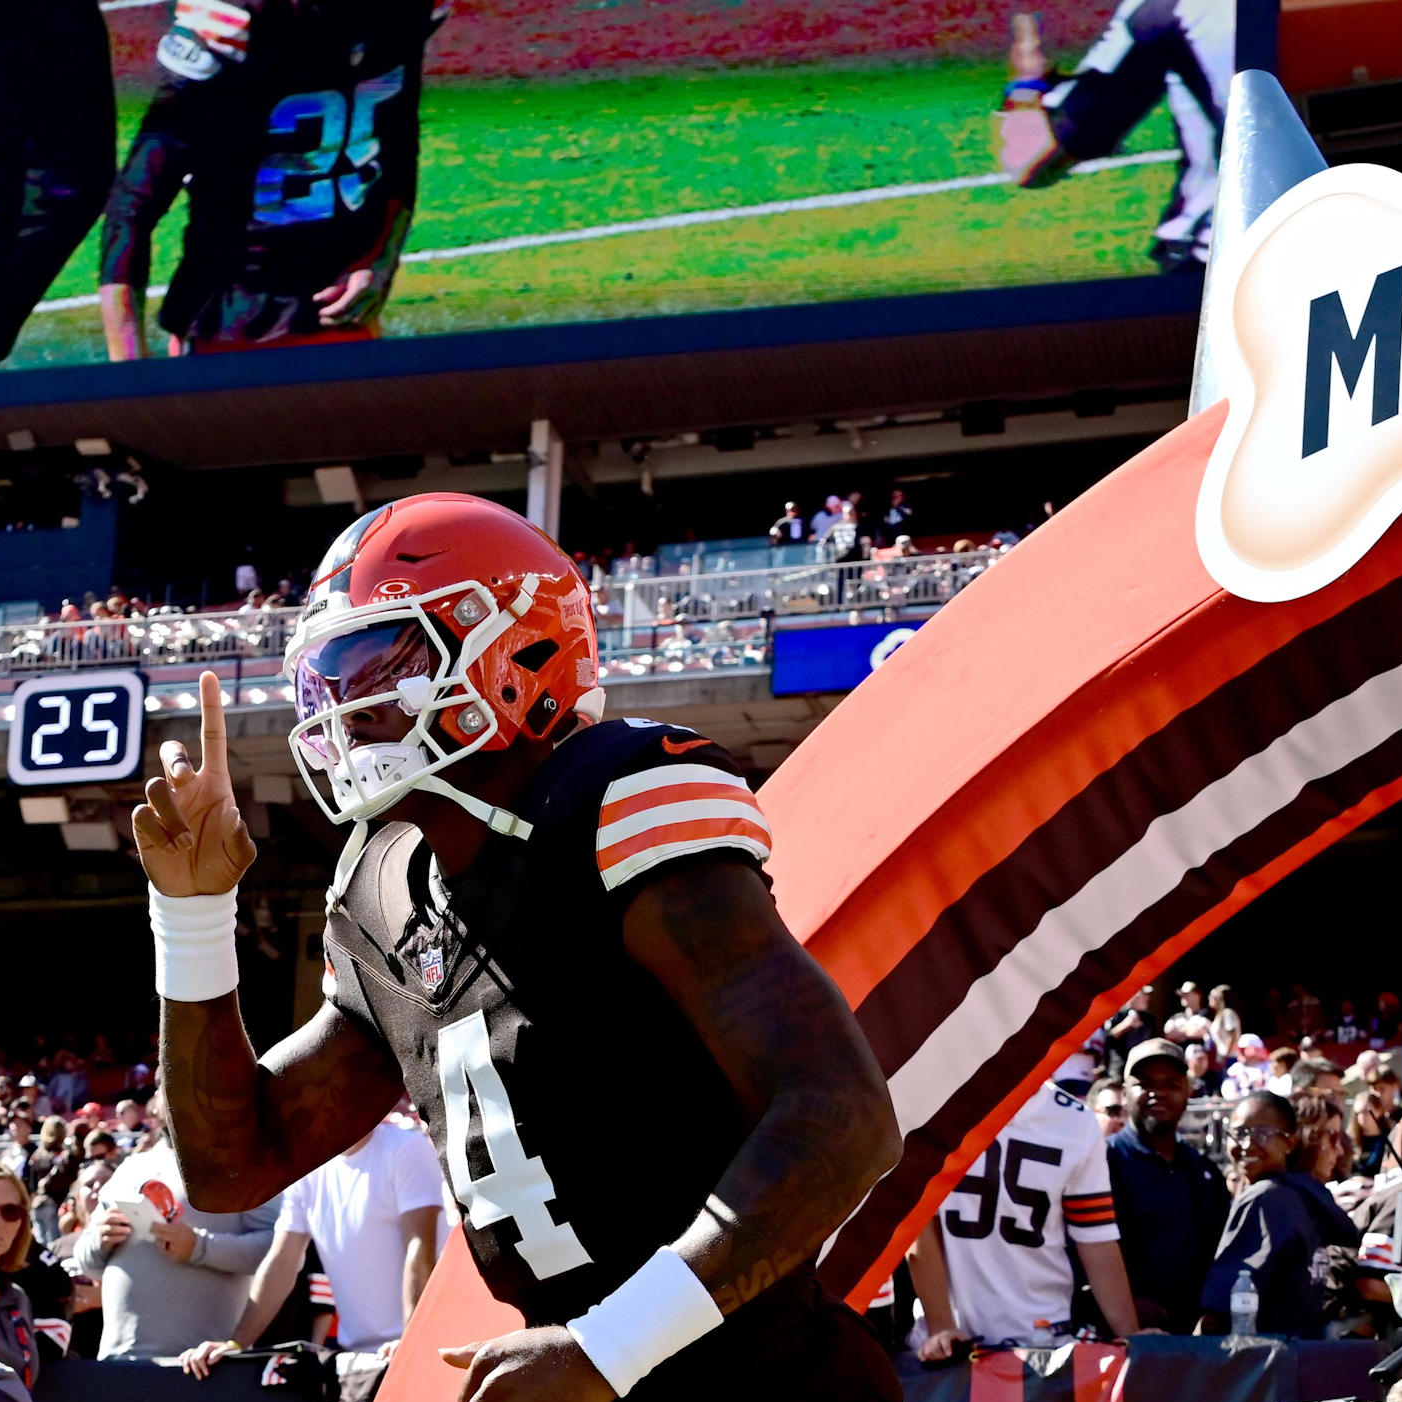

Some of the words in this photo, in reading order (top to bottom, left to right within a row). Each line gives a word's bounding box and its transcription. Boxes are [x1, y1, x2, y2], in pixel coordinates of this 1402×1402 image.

[30, 689, 119, 767] 25
[425, 965, 442, 984] NFL
[437, 1008, 595, 1282] 4
[945, 1137, 1063, 1248] 95
